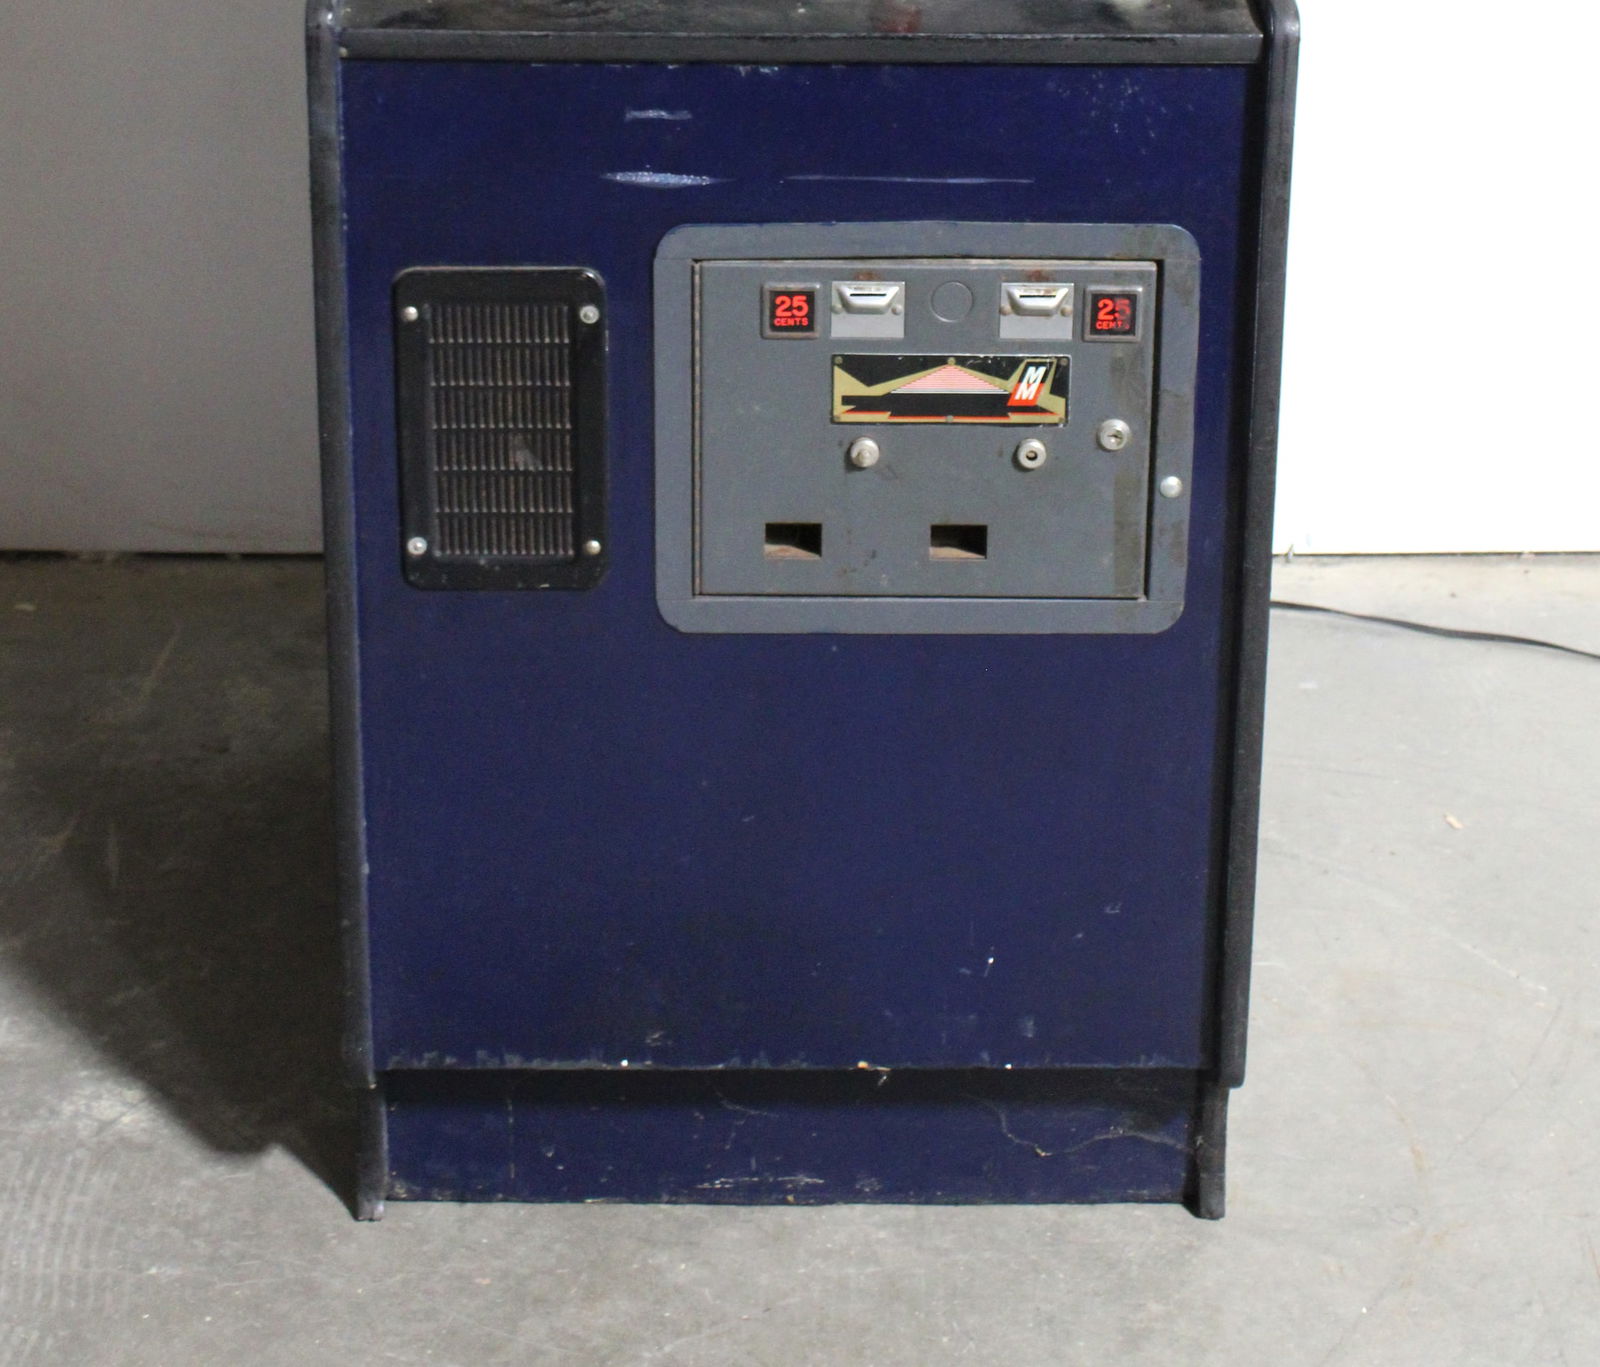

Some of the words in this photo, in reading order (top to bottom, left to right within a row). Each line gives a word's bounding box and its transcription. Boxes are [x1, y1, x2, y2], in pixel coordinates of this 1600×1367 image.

[775, 294, 809, 317] 25
[1097, 297, 1131, 320] 25
[773, 317, 809, 327] CENTS
